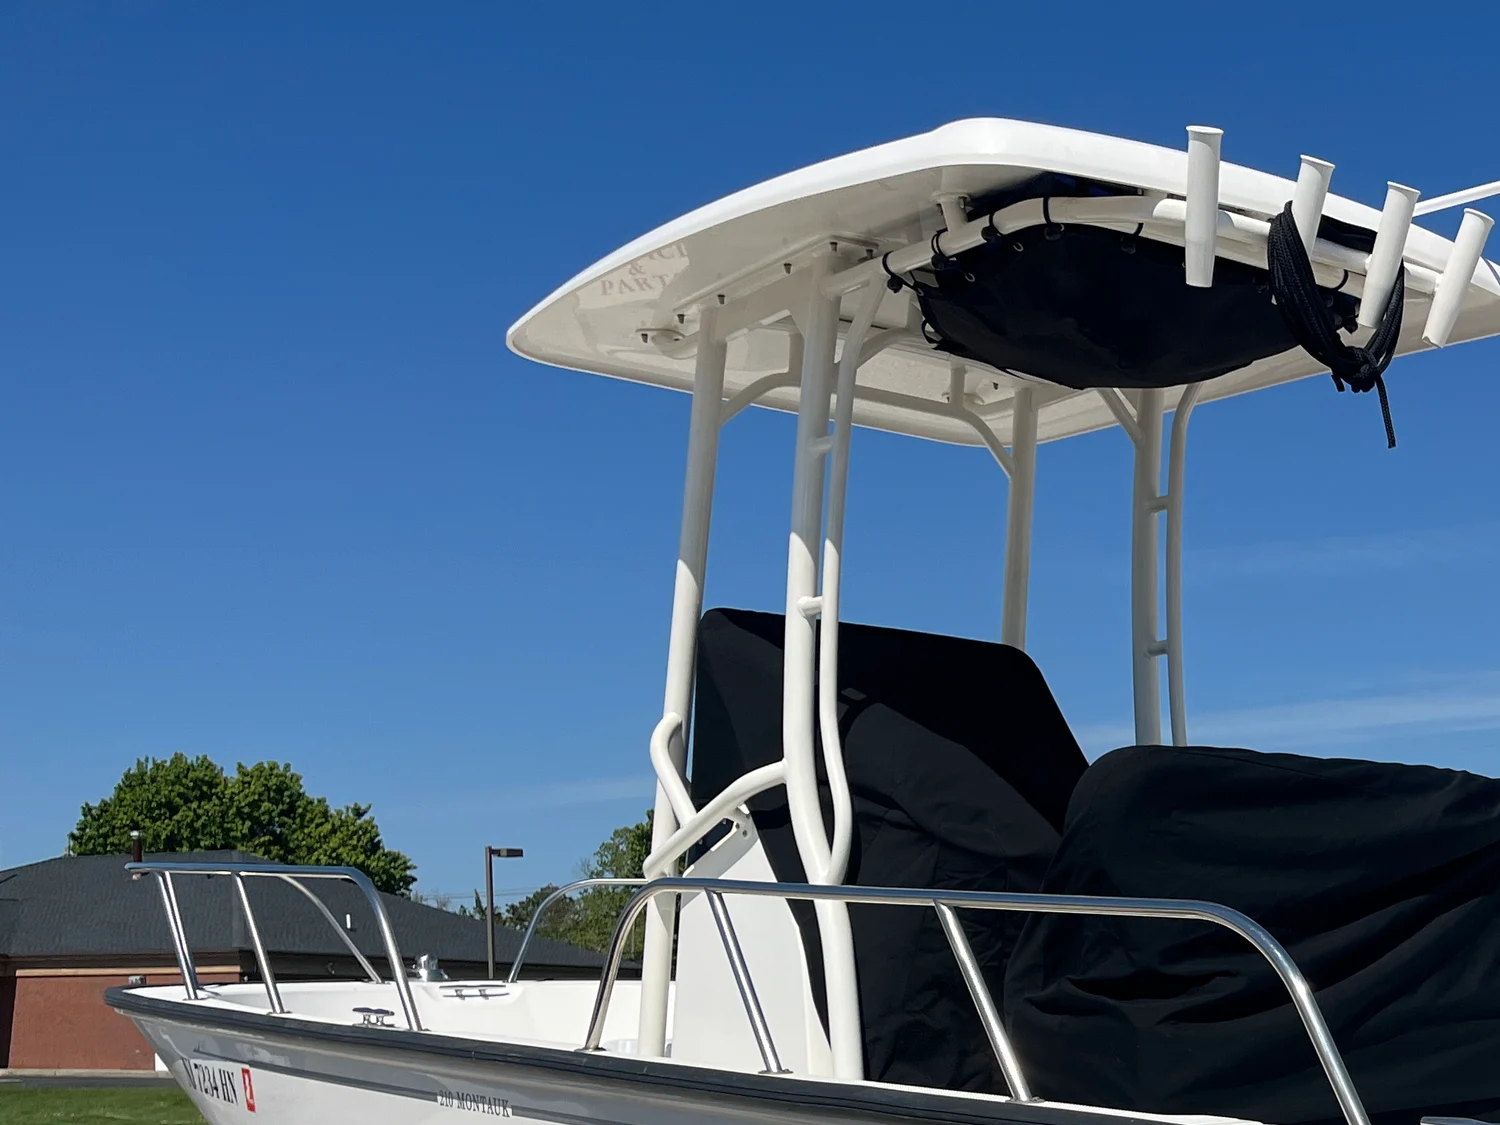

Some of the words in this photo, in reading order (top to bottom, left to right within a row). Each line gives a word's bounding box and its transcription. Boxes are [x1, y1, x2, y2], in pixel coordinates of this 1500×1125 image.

[217, 1068, 239, 1106] HN
[438, 1090, 454, 1108] 210
[456, 1091, 511, 1118] MONTAUK
